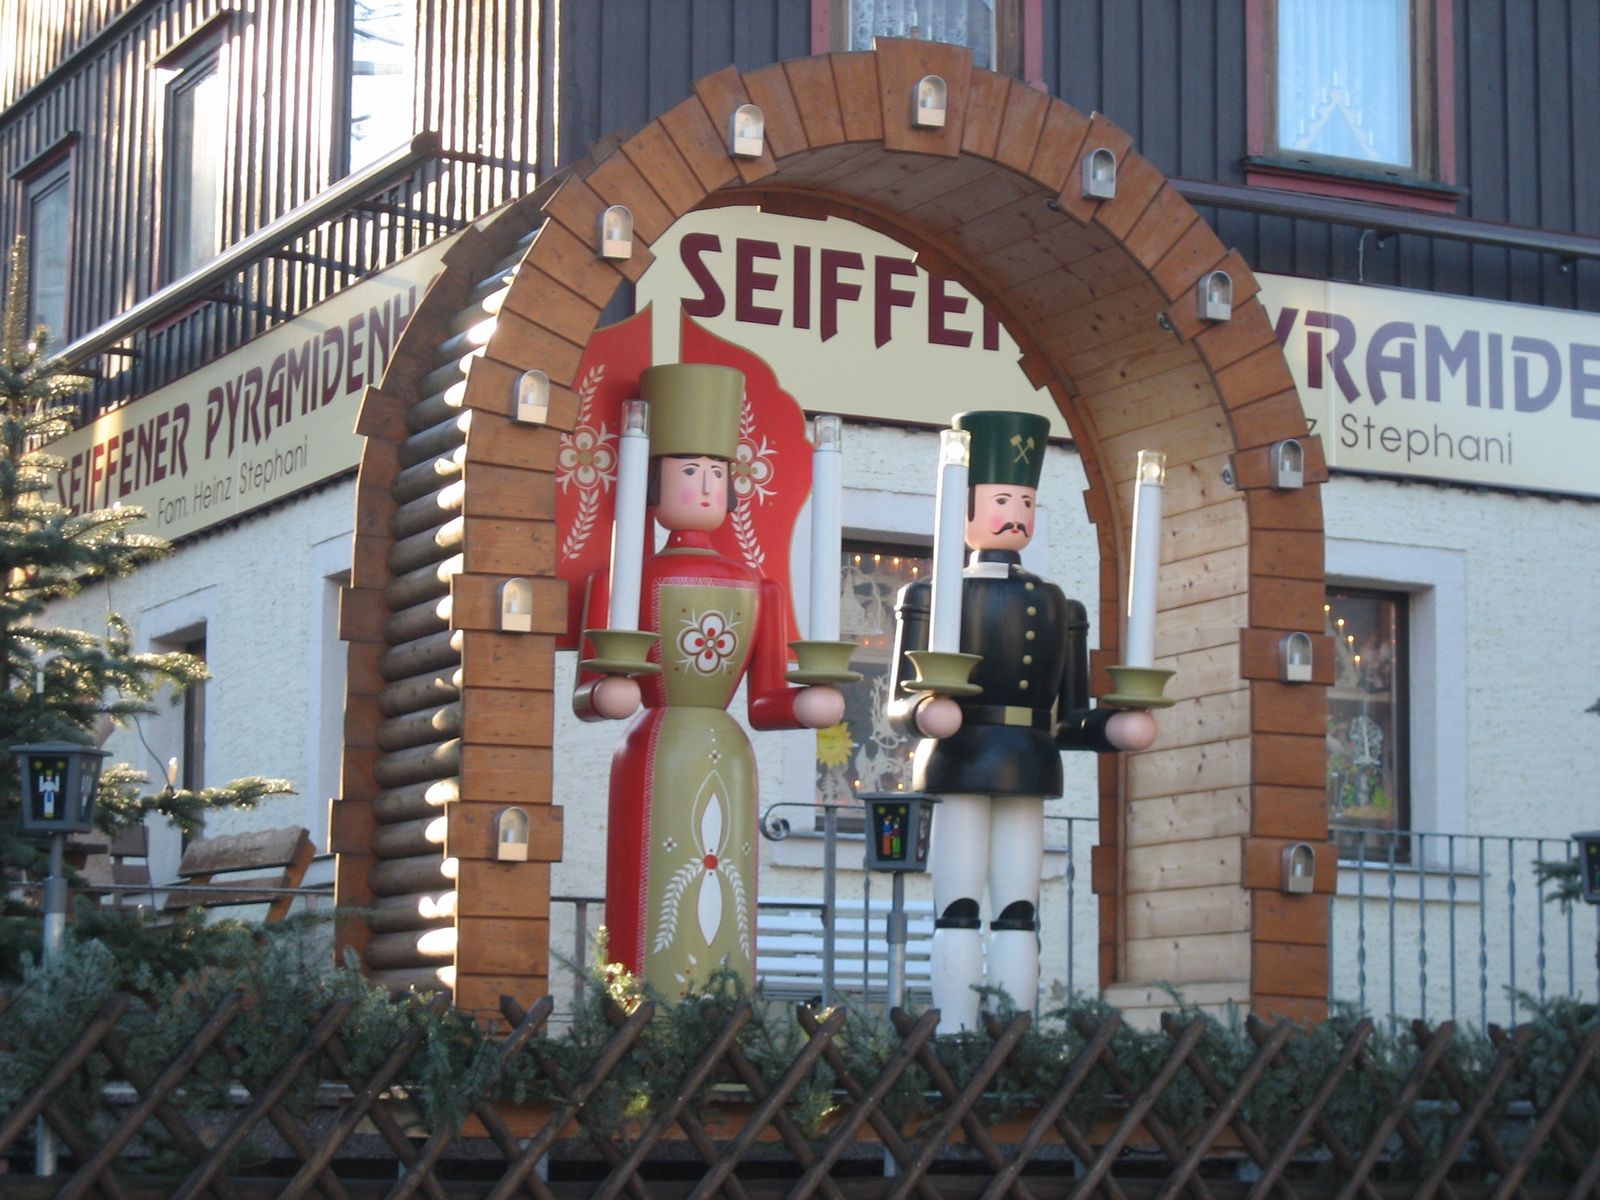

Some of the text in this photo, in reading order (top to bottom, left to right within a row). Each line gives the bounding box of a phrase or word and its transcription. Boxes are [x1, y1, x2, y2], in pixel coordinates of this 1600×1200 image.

[1340, 413, 1513, 465] Stephani
[157, 434, 308, 527] Fam. Heinz Stephani
